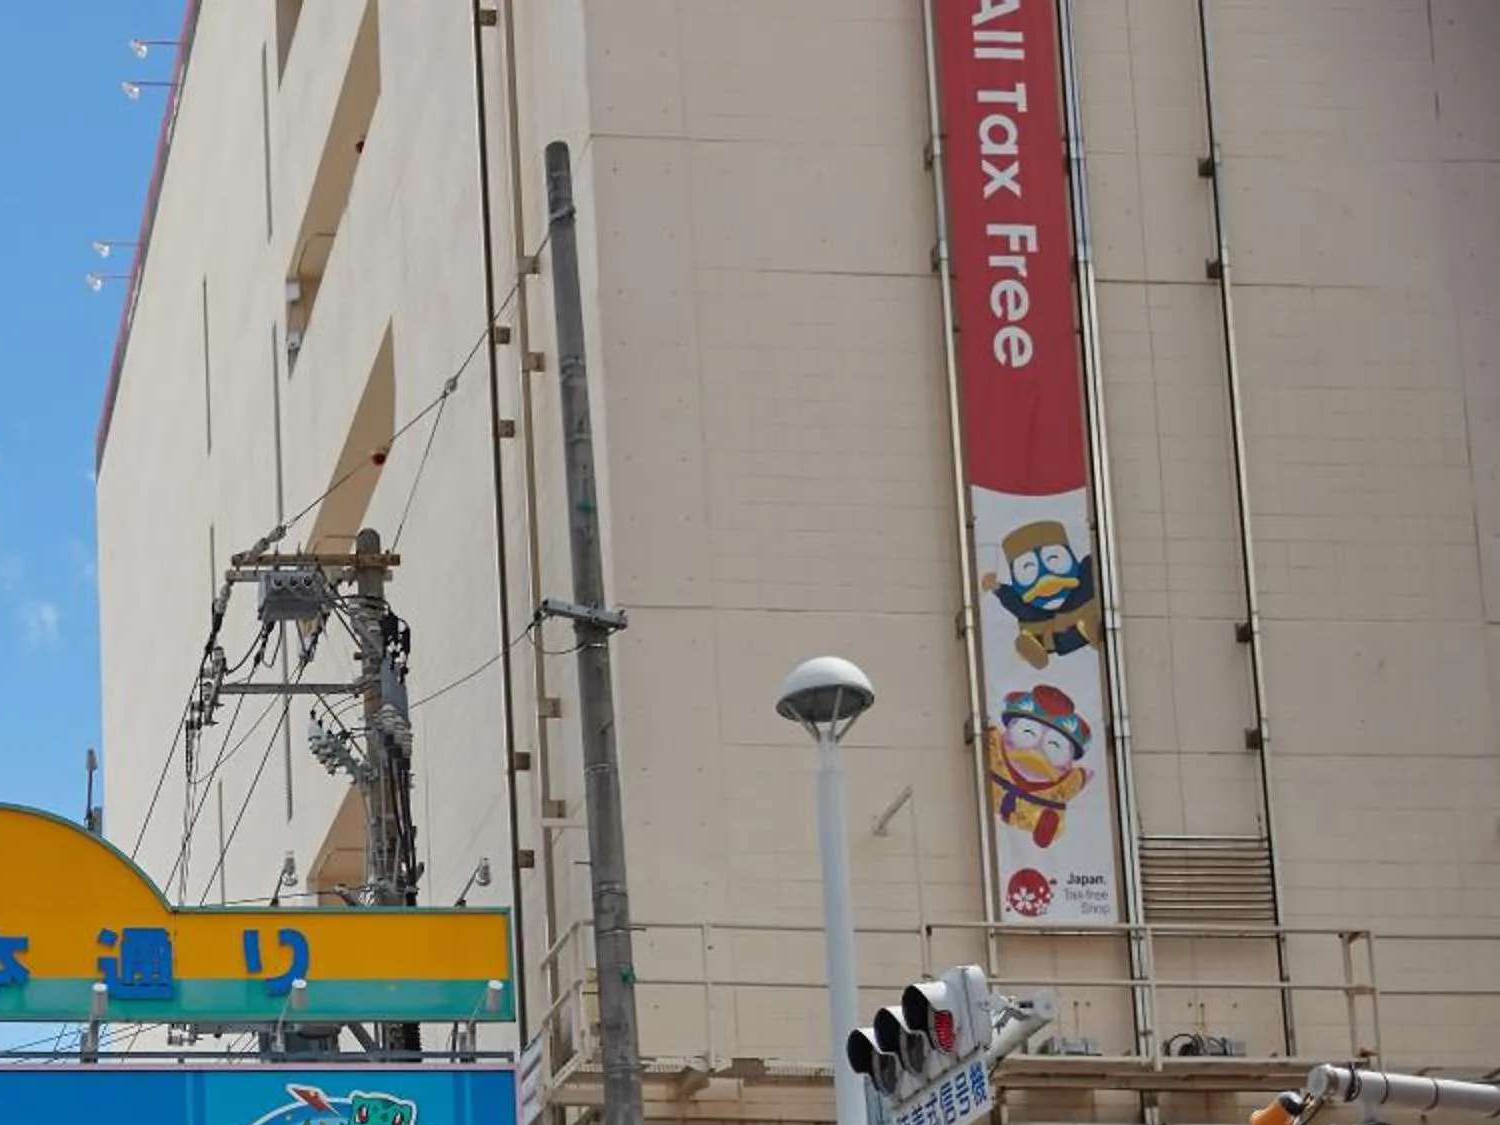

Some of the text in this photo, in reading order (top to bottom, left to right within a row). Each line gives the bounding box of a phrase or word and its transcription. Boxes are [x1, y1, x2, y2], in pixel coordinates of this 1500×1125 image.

[972, 0, 1038, 368] All Tax Free
